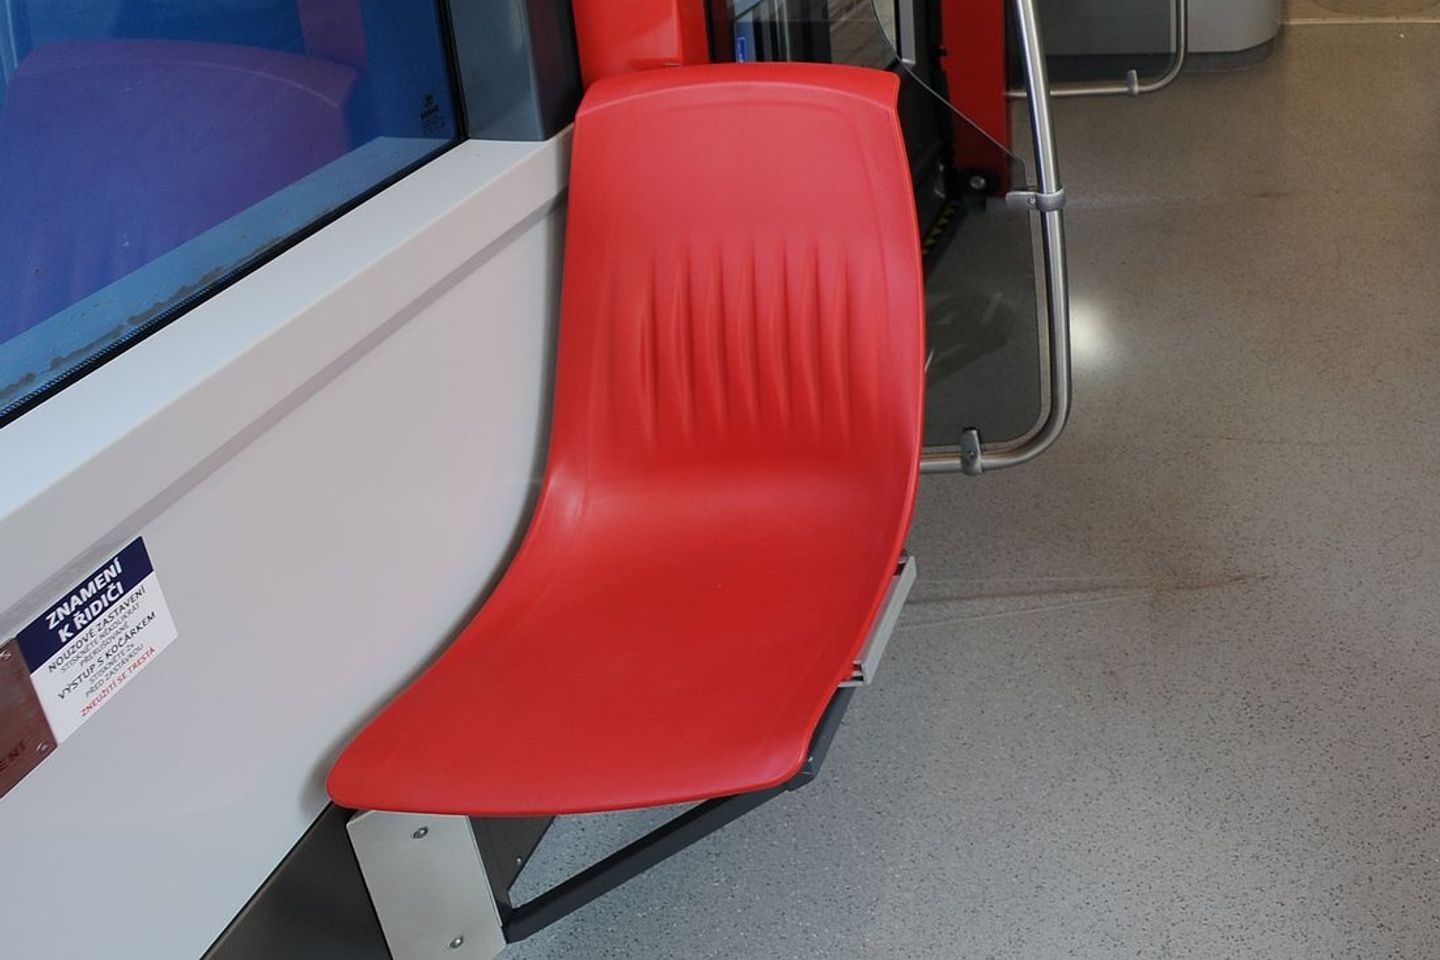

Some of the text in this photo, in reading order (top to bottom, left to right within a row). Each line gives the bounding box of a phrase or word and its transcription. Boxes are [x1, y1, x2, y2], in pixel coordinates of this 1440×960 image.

[45, 557, 123, 630] ZNAMENÍ
[58, 581, 124, 643] K ŘIDIČI
[96, 583, 146, 632] ZASTAVENÍ
[58, 663, 96, 699] VÝSTUP
[105, 611, 156, 659] KOČÁRKEM
